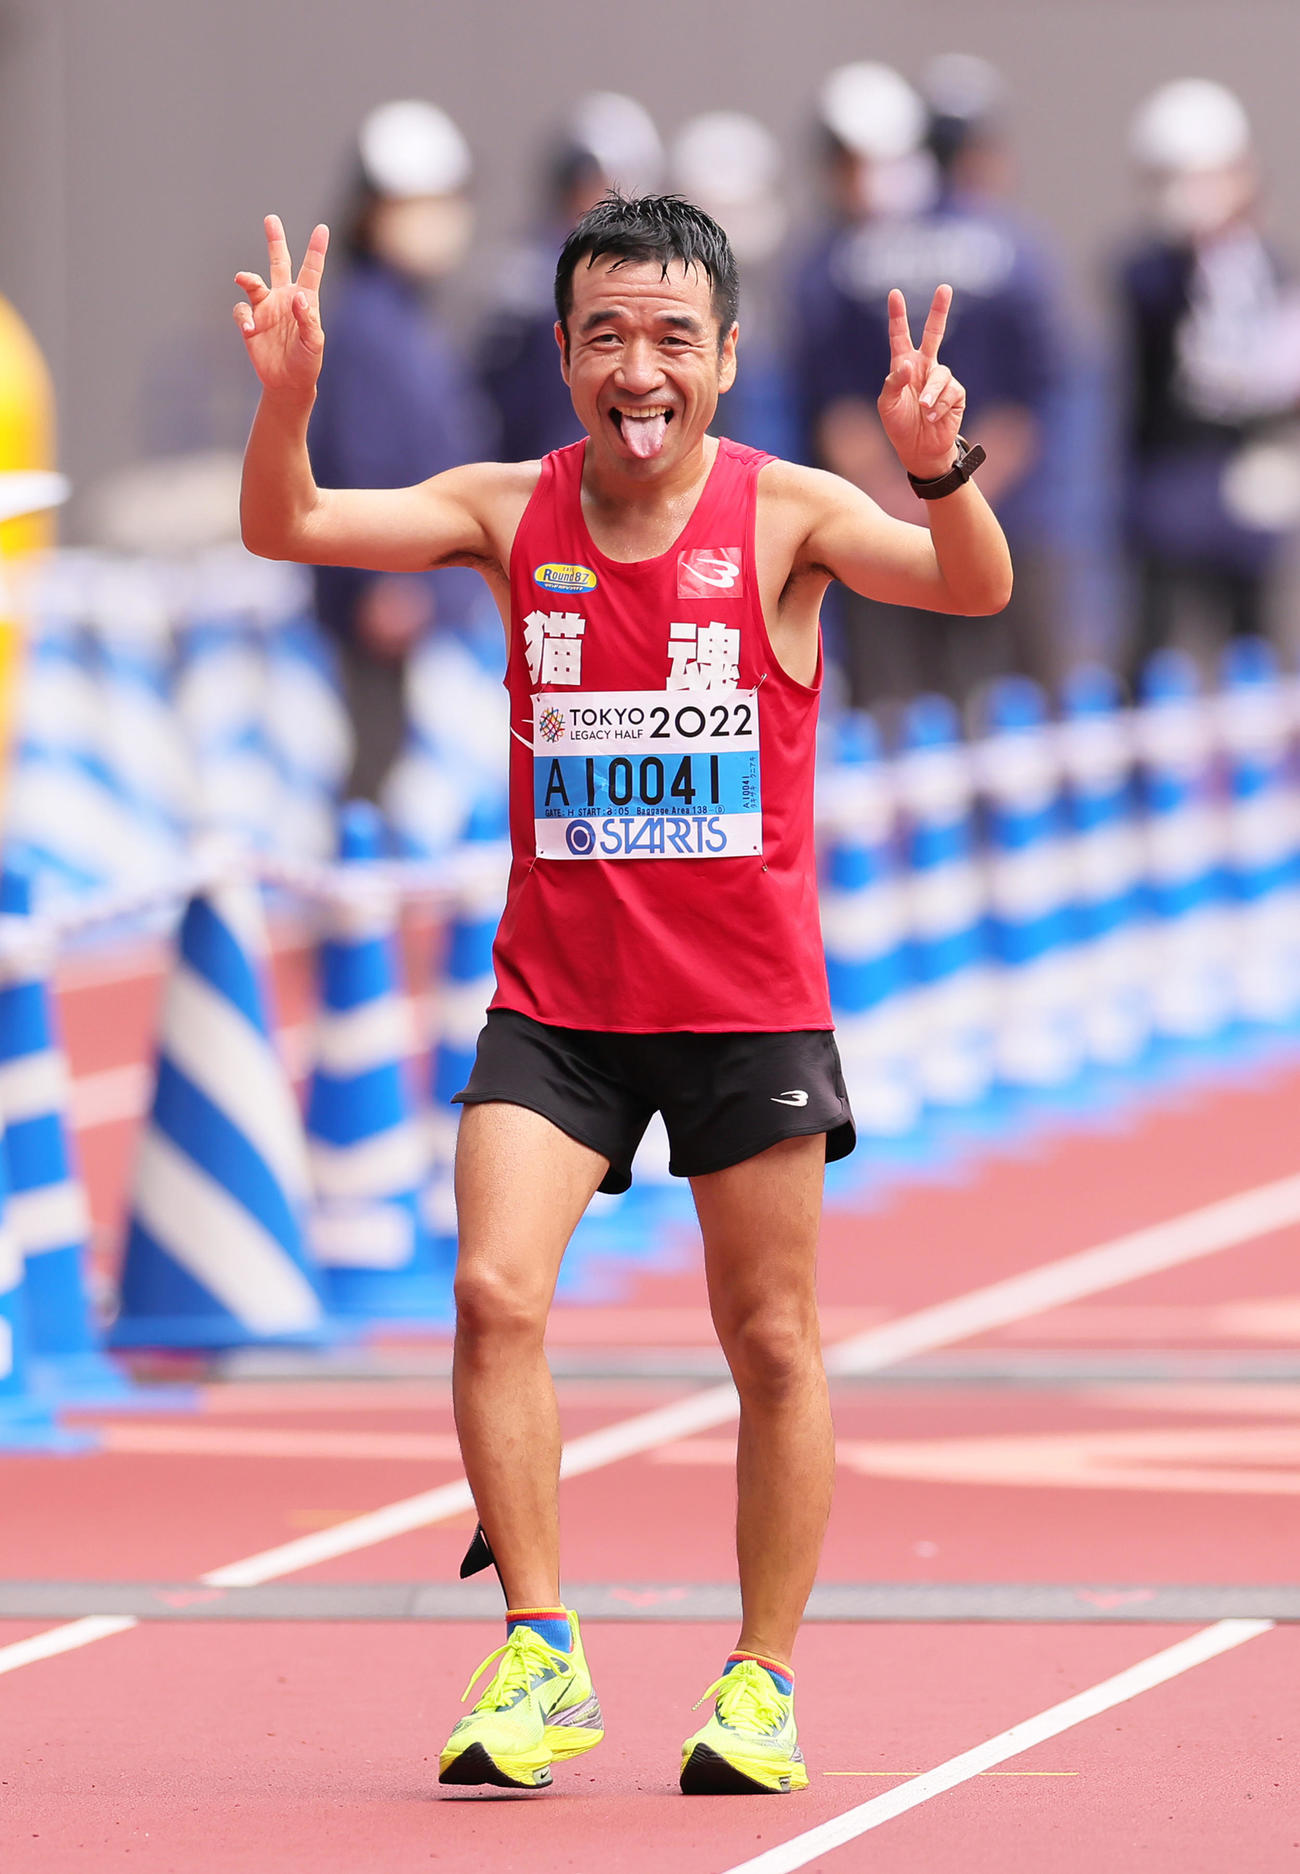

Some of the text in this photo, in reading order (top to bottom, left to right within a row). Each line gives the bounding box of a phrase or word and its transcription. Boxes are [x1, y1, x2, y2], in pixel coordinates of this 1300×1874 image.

[523, 610, 740, 690] 猫 魂
[570, 704, 752, 738] TOKYO 2022
[571, 729, 643, 741] LEGACY HALF
[545, 755, 719, 806] A10041
[741, 776, 750, 808] A10041
[545, 808, 565, 817] GATE:
[567, 809, 574, 817] H
[636, 806, 669, 816] Baggage
[671, 806, 690, 815] Area
[600, 817, 727, 854] STARTS
